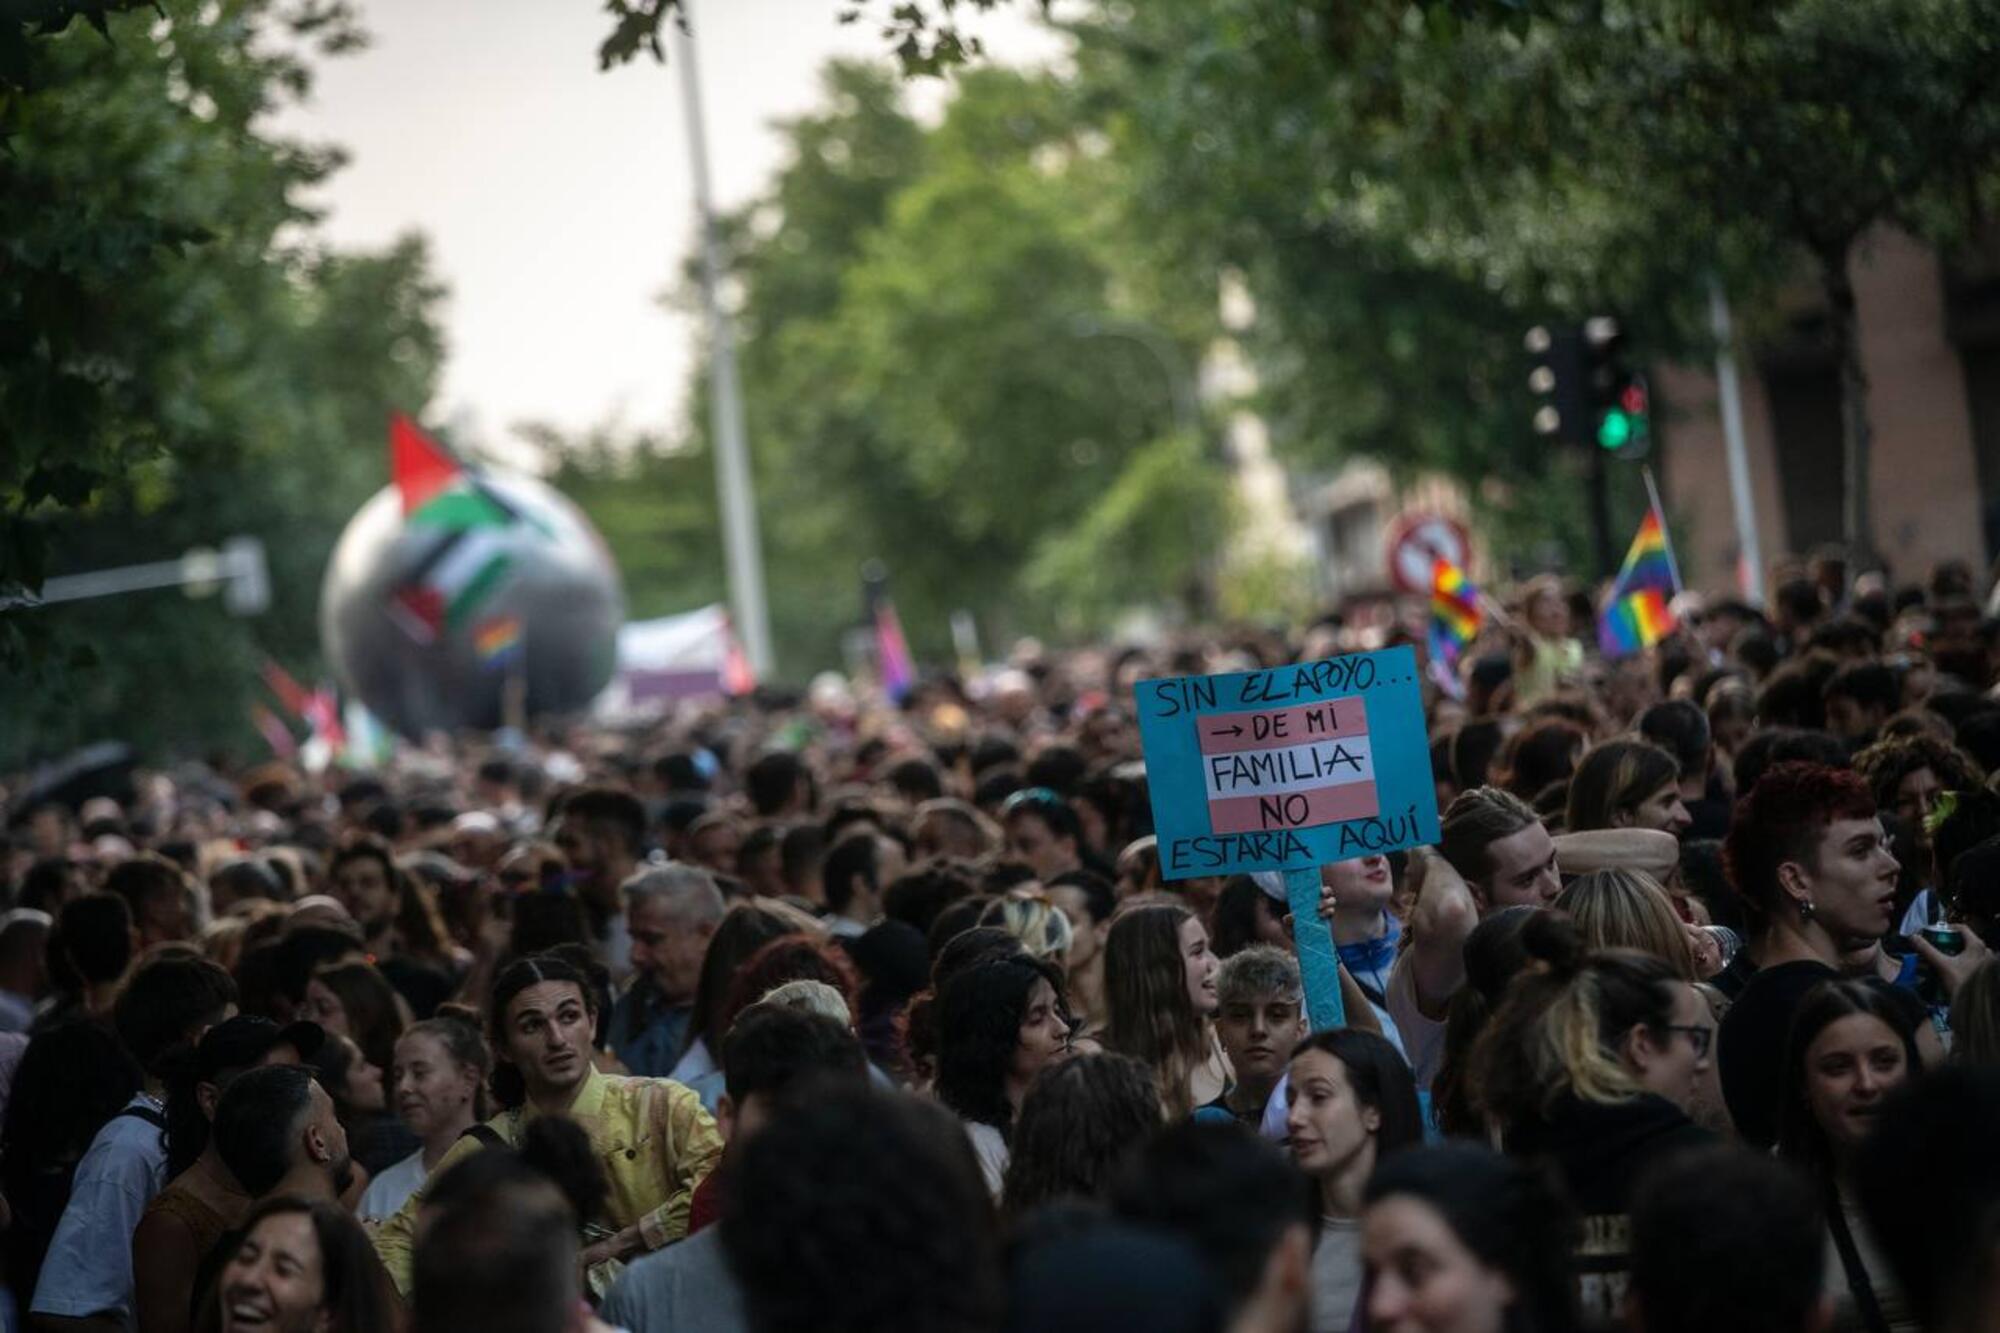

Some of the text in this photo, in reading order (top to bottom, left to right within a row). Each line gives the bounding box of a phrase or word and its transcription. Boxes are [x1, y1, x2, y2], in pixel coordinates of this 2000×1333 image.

[1156, 677, 1217, 717] SIN
[1240, 673, 1291, 703] EL
[1252, 702, 1338, 741] DE MI
[1211, 744, 1365, 791] FAMILIA
[1260, 794, 1310, 829] NO
[1339, 805, 1420, 855] AQUÍ
